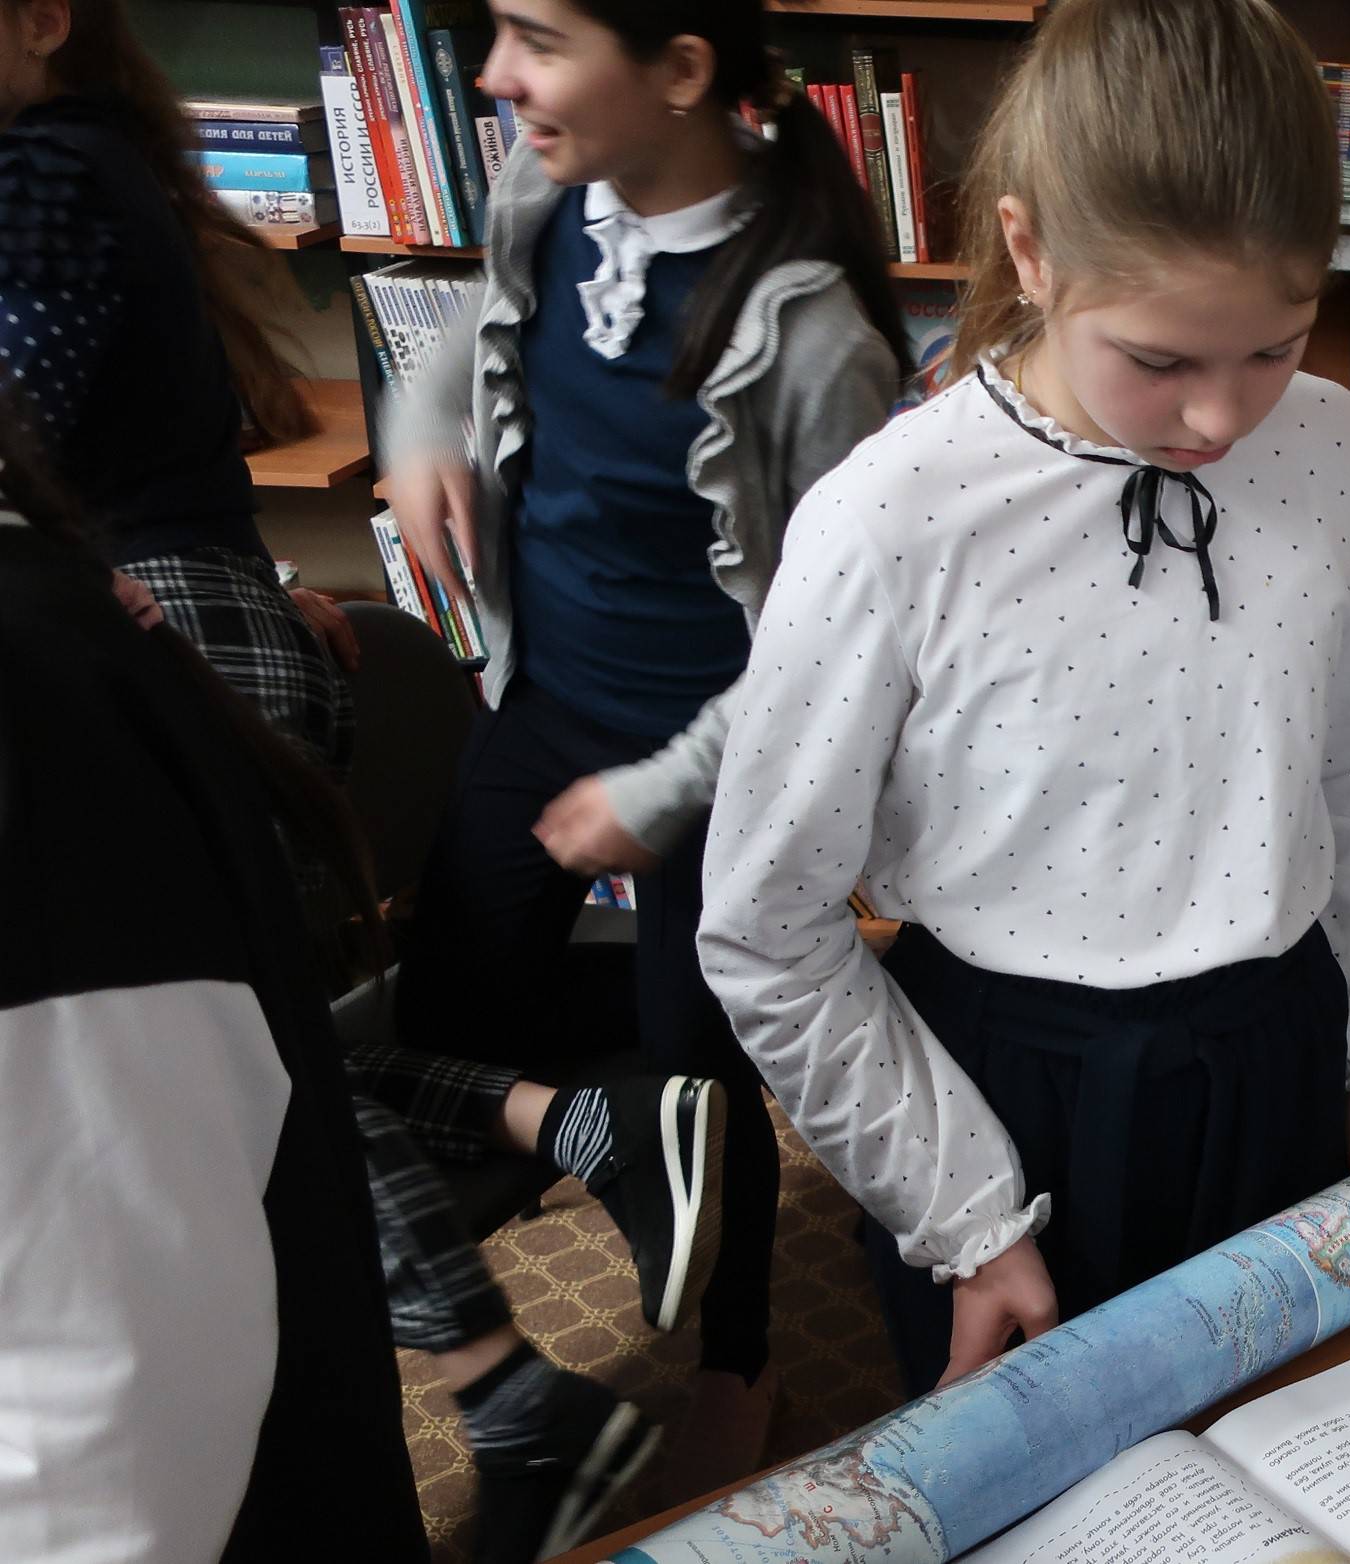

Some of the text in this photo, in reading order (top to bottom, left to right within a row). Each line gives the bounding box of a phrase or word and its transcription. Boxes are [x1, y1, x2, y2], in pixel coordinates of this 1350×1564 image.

[346, 19, 355, 38] РУСЬ
[358, 18, 367, 37] РУСЬ
[232, 130, 254, 140] ДЛЯ
[258, 130, 293, 141] ДЕТЕЙ
[334, 107, 355, 184] ИСТОРИЯ
[349, 82, 379, 208] РОССИИ И СССР
[483, 120, 502, 172] ОЖИНОВ
[1269, 1445, 1300, 1467] спасибо
[1308, 1460, 1334, 1474] шума,
[1286, 1455, 1323, 1480] полезной
[1302, 1470, 1334, 1493] машину
[1123, 1493, 1142, 1508] себя
[1108, 1497, 1155, 1536] объяснение
[1122, 1504, 1166, 1539] заставляет
[1086, 1517, 1112, 1539] конце
[1134, 1520, 1160, 1544] может
[1262, 1525, 1309, 1547] Задание
[1100, 1540, 1118, 1556] этот
[1175, 1536, 1196, 1554] этом
[1211, 1531, 1246, 1552] знаешь,
